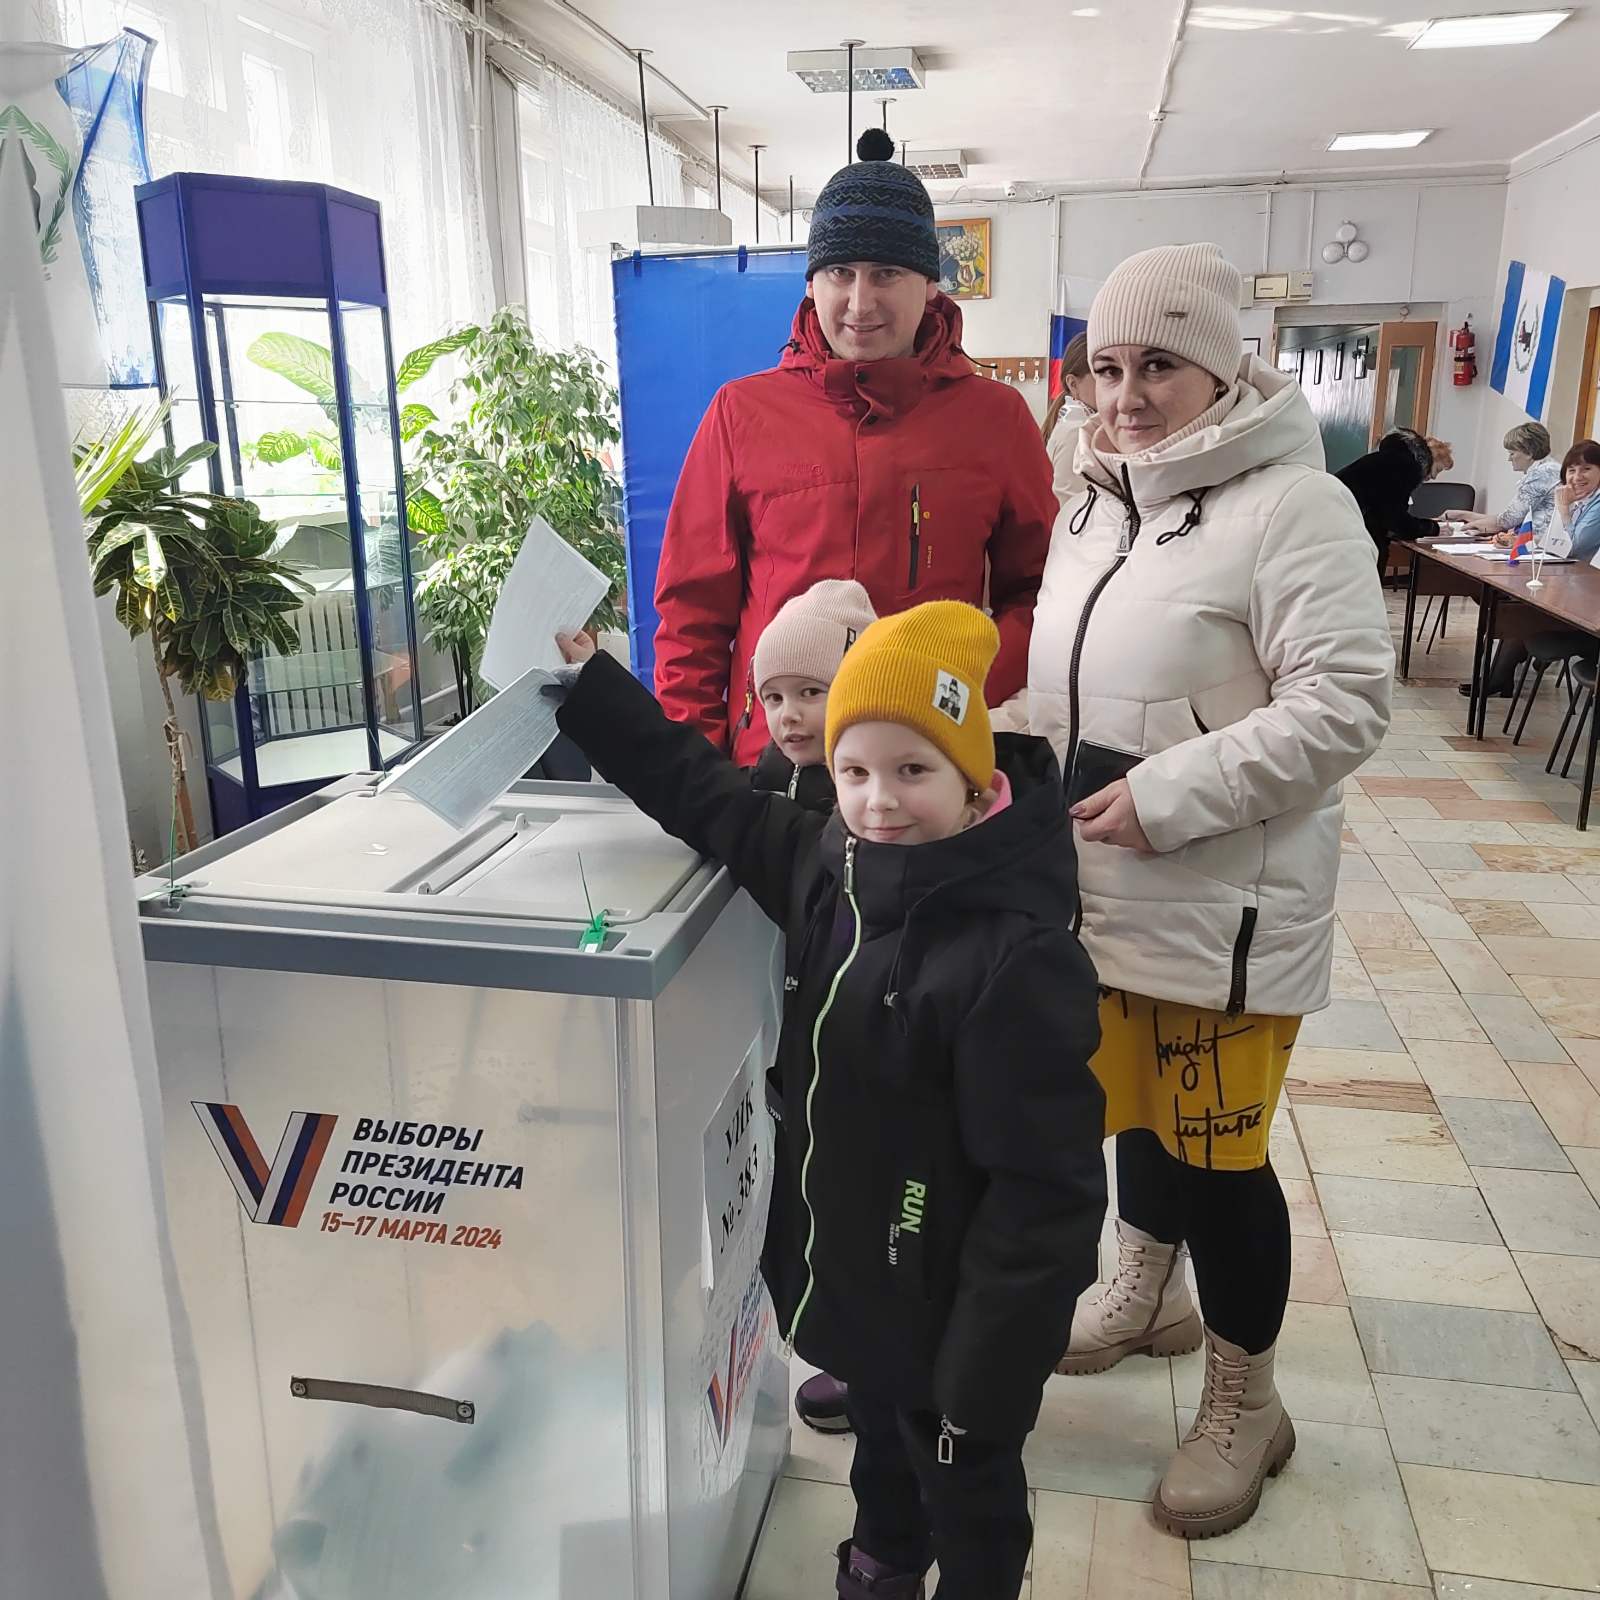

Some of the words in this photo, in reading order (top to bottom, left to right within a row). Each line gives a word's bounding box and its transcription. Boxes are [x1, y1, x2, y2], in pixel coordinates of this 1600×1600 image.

[1153, 1004, 1255, 1110] bright
[352, 1118, 484, 1152] ВЫБОРЫ
[1173, 1093, 1267, 1170] future
[340, 1151, 525, 1190] ПРЕЗИДЕНТА
[328, 1182, 446, 1215] РОССИИ
[900, 1179, 926, 1234] RUN
[377, 1219, 447, 1245] МАРТА
[450, 1226, 502, 1250] 2024
